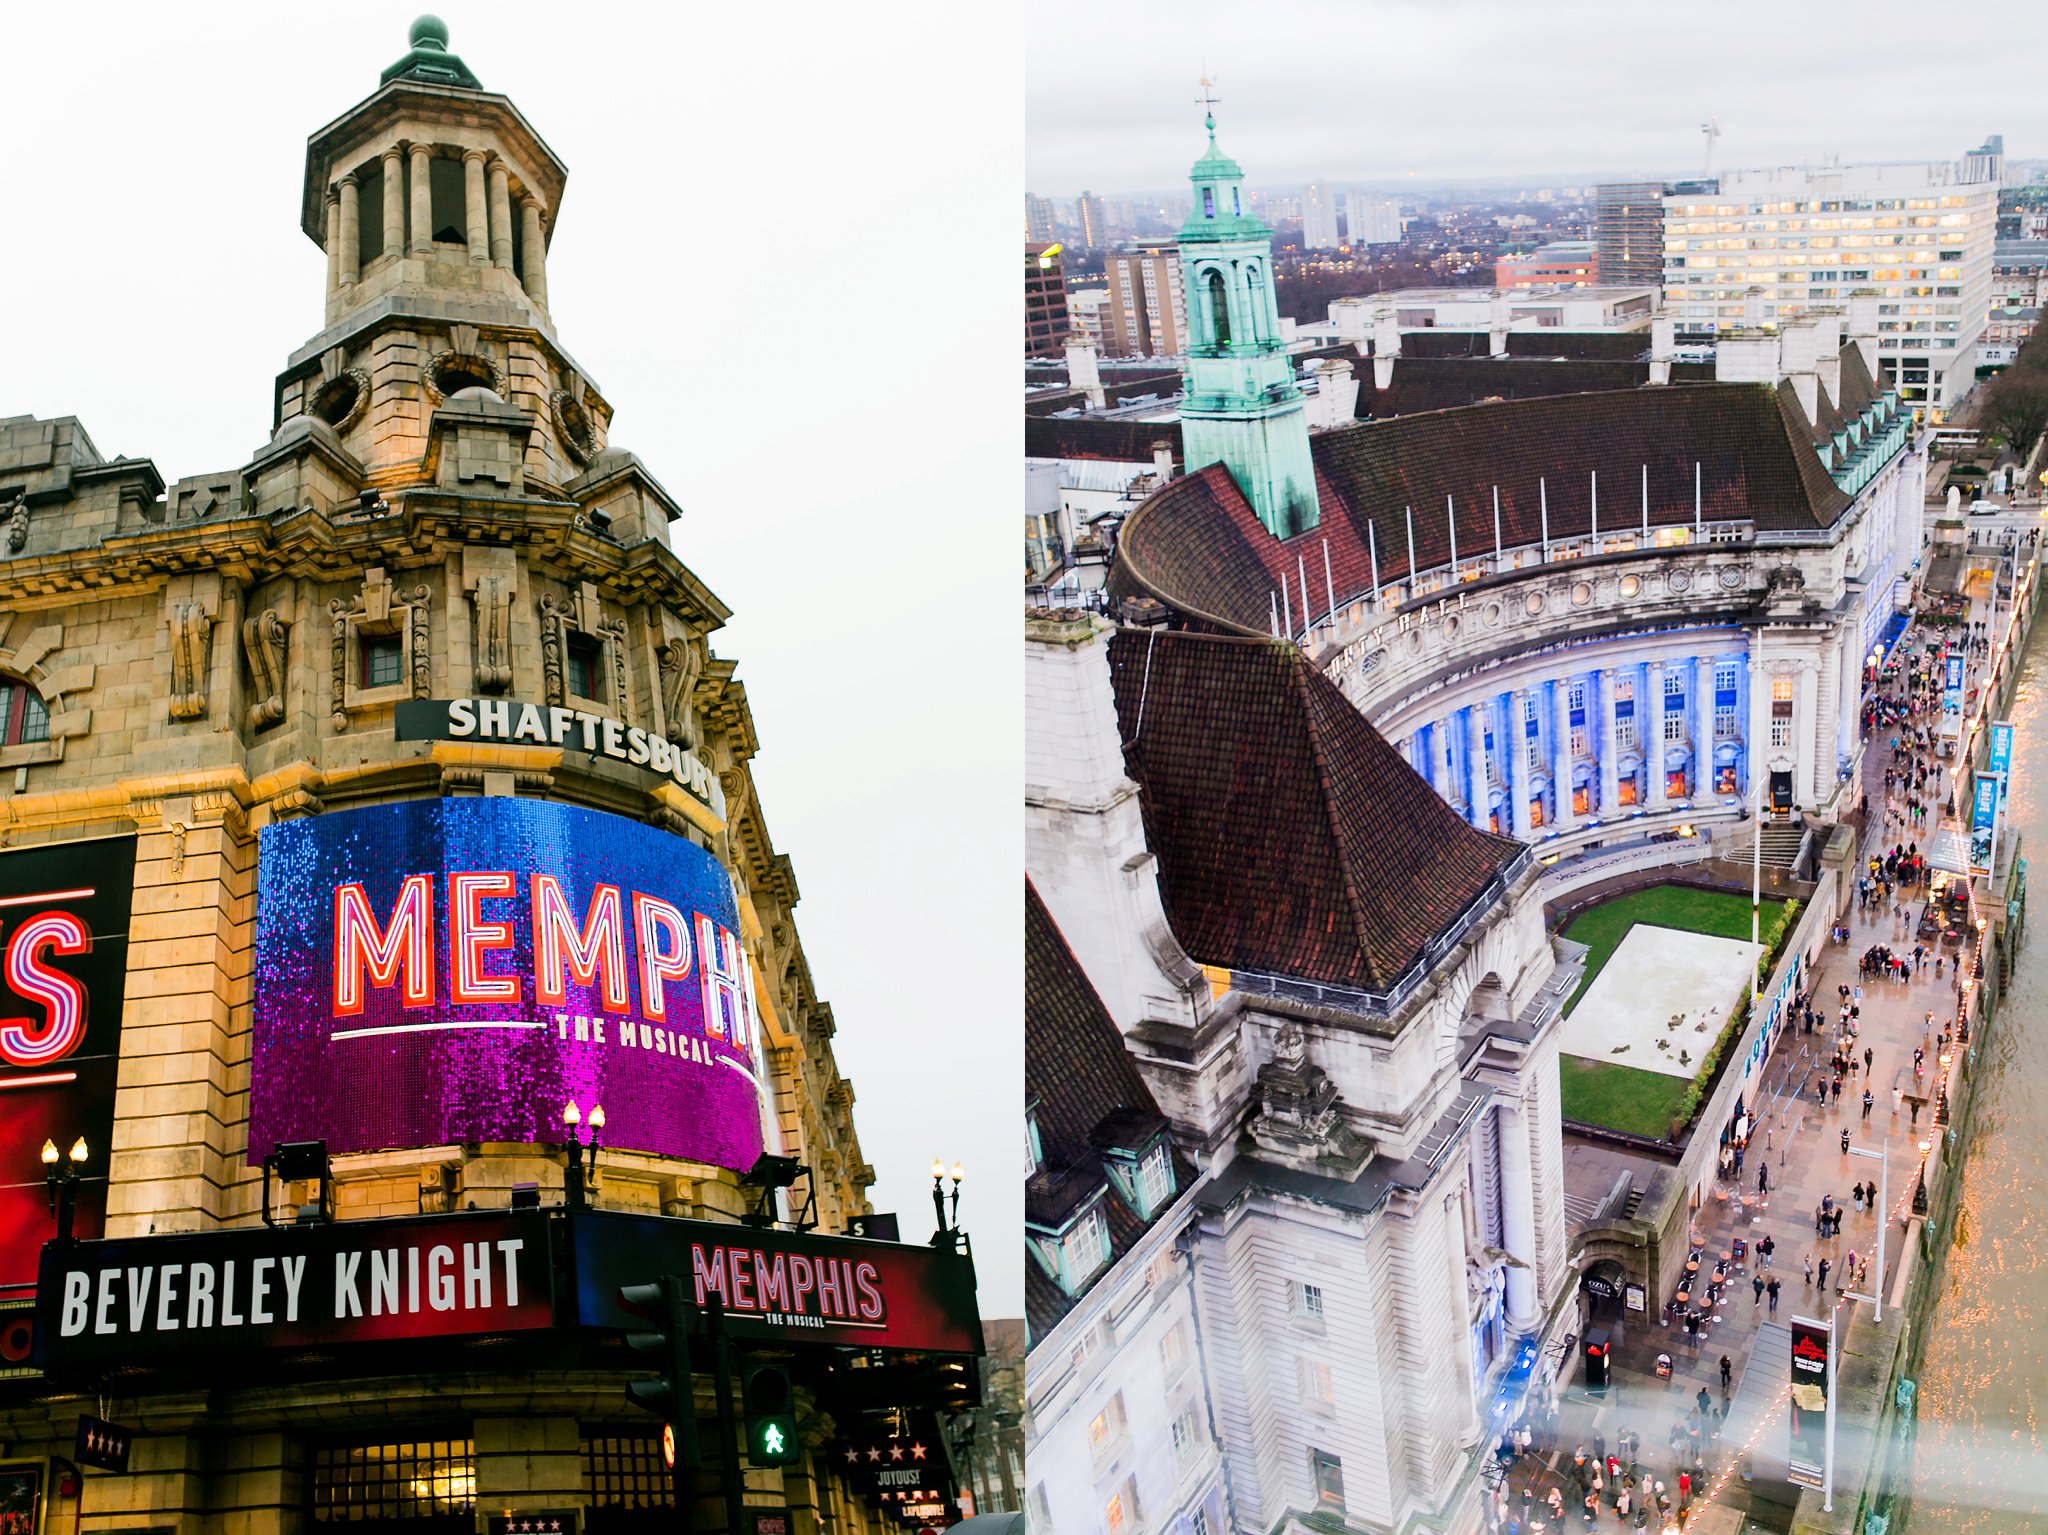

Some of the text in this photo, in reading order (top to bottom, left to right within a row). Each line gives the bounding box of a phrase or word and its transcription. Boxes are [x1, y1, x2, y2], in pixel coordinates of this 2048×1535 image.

[1399, 593, 1470, 634] HALL
[448, 699, 718, 808] SHAFTESBURY
[555, 1014, 714, 1066] THE MUSICAL
[60, 1239, 523, 1337] BEVERLEY KNIGHT
[691, 1243, 886, 1323] MEMPHIS
[766, 1313, 825, 1328] THE MUSICAL
